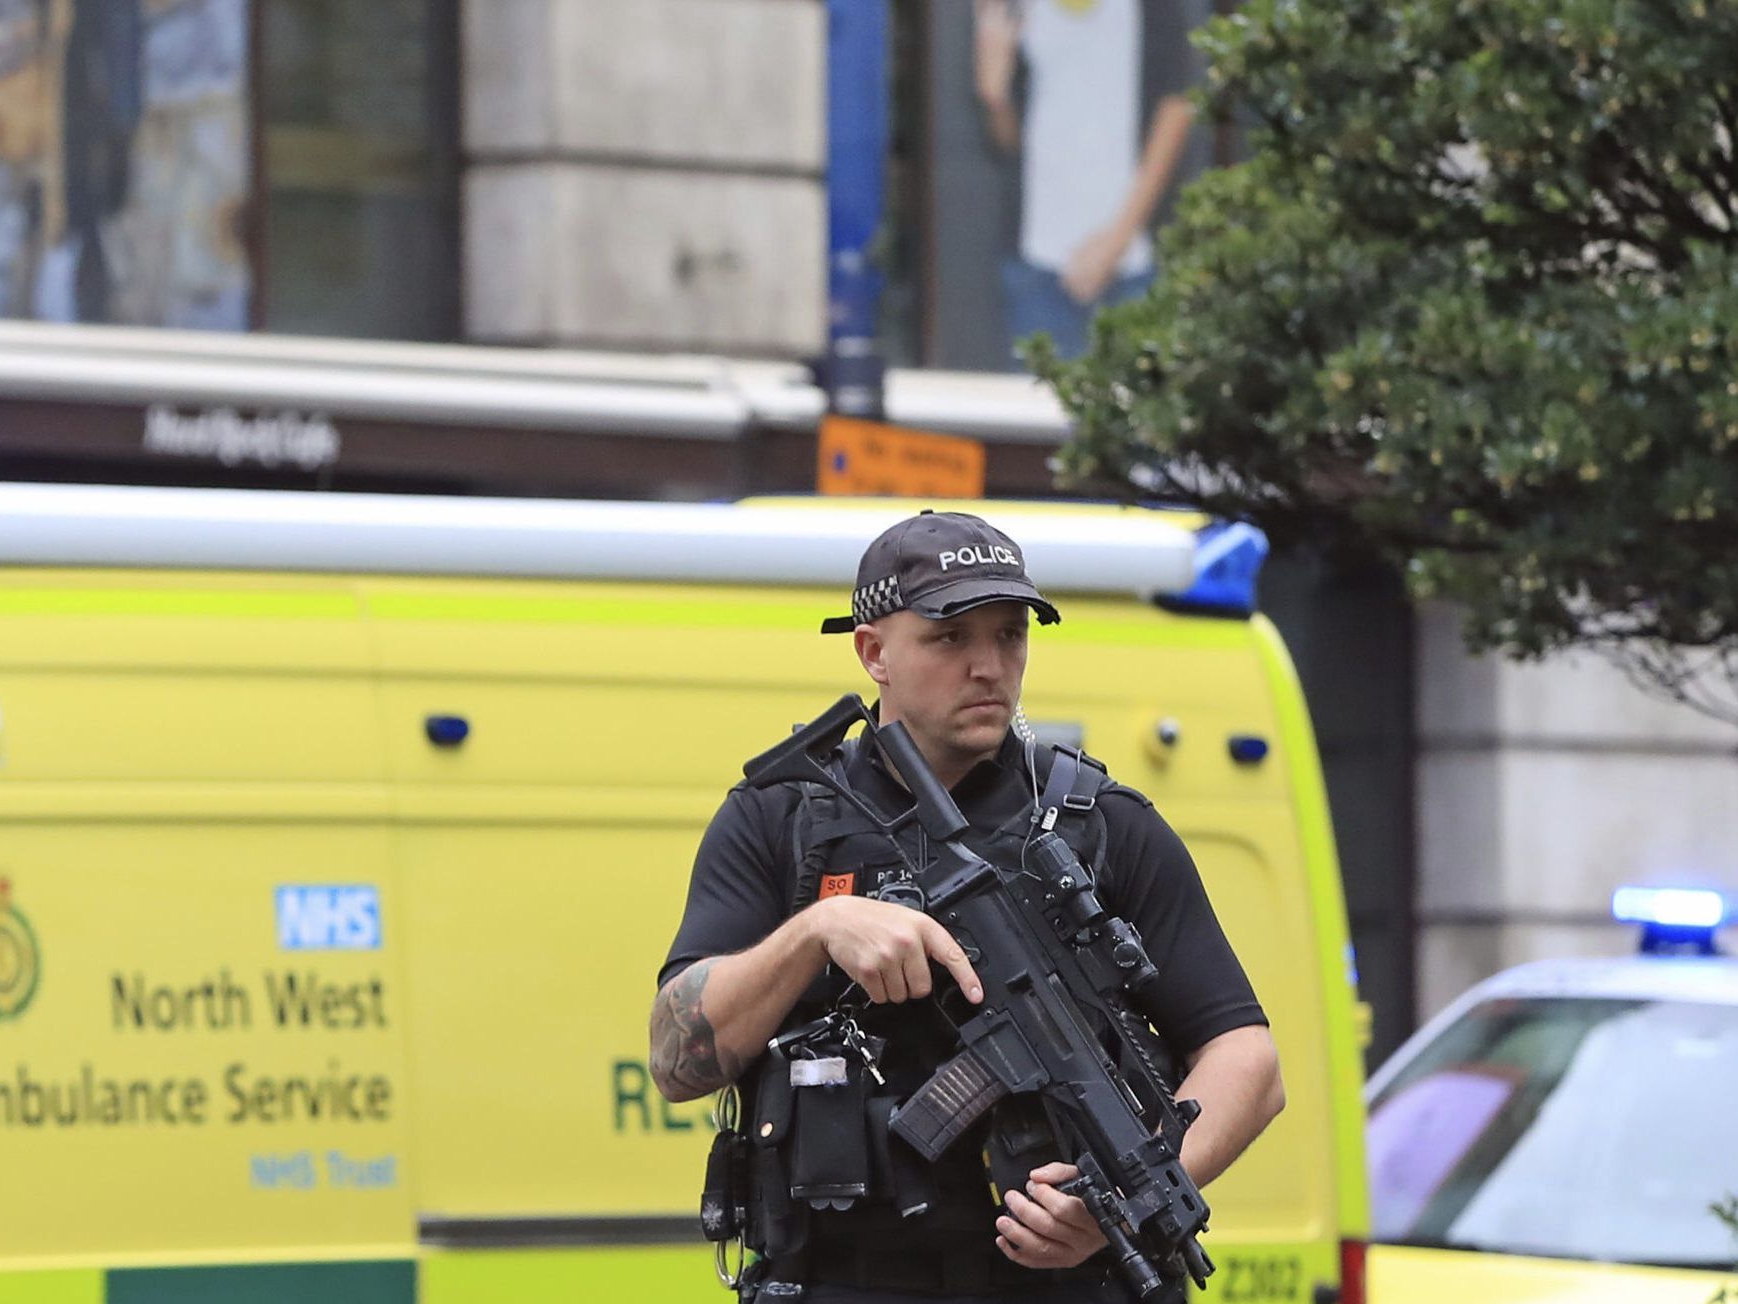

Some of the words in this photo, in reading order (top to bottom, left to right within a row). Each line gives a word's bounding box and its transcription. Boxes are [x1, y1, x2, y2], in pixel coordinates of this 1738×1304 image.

[939, 545, 1019, 571] POLICE
[277, 886, 381, 949] NHS
[111, 966, 251, 1030] North
[265, 972, 388, 1029] West
[224, 1058, 392, 1125] Service
[249, 1153, 315, 1188] NHS
[326, 1151, 397, 1187] Trust
